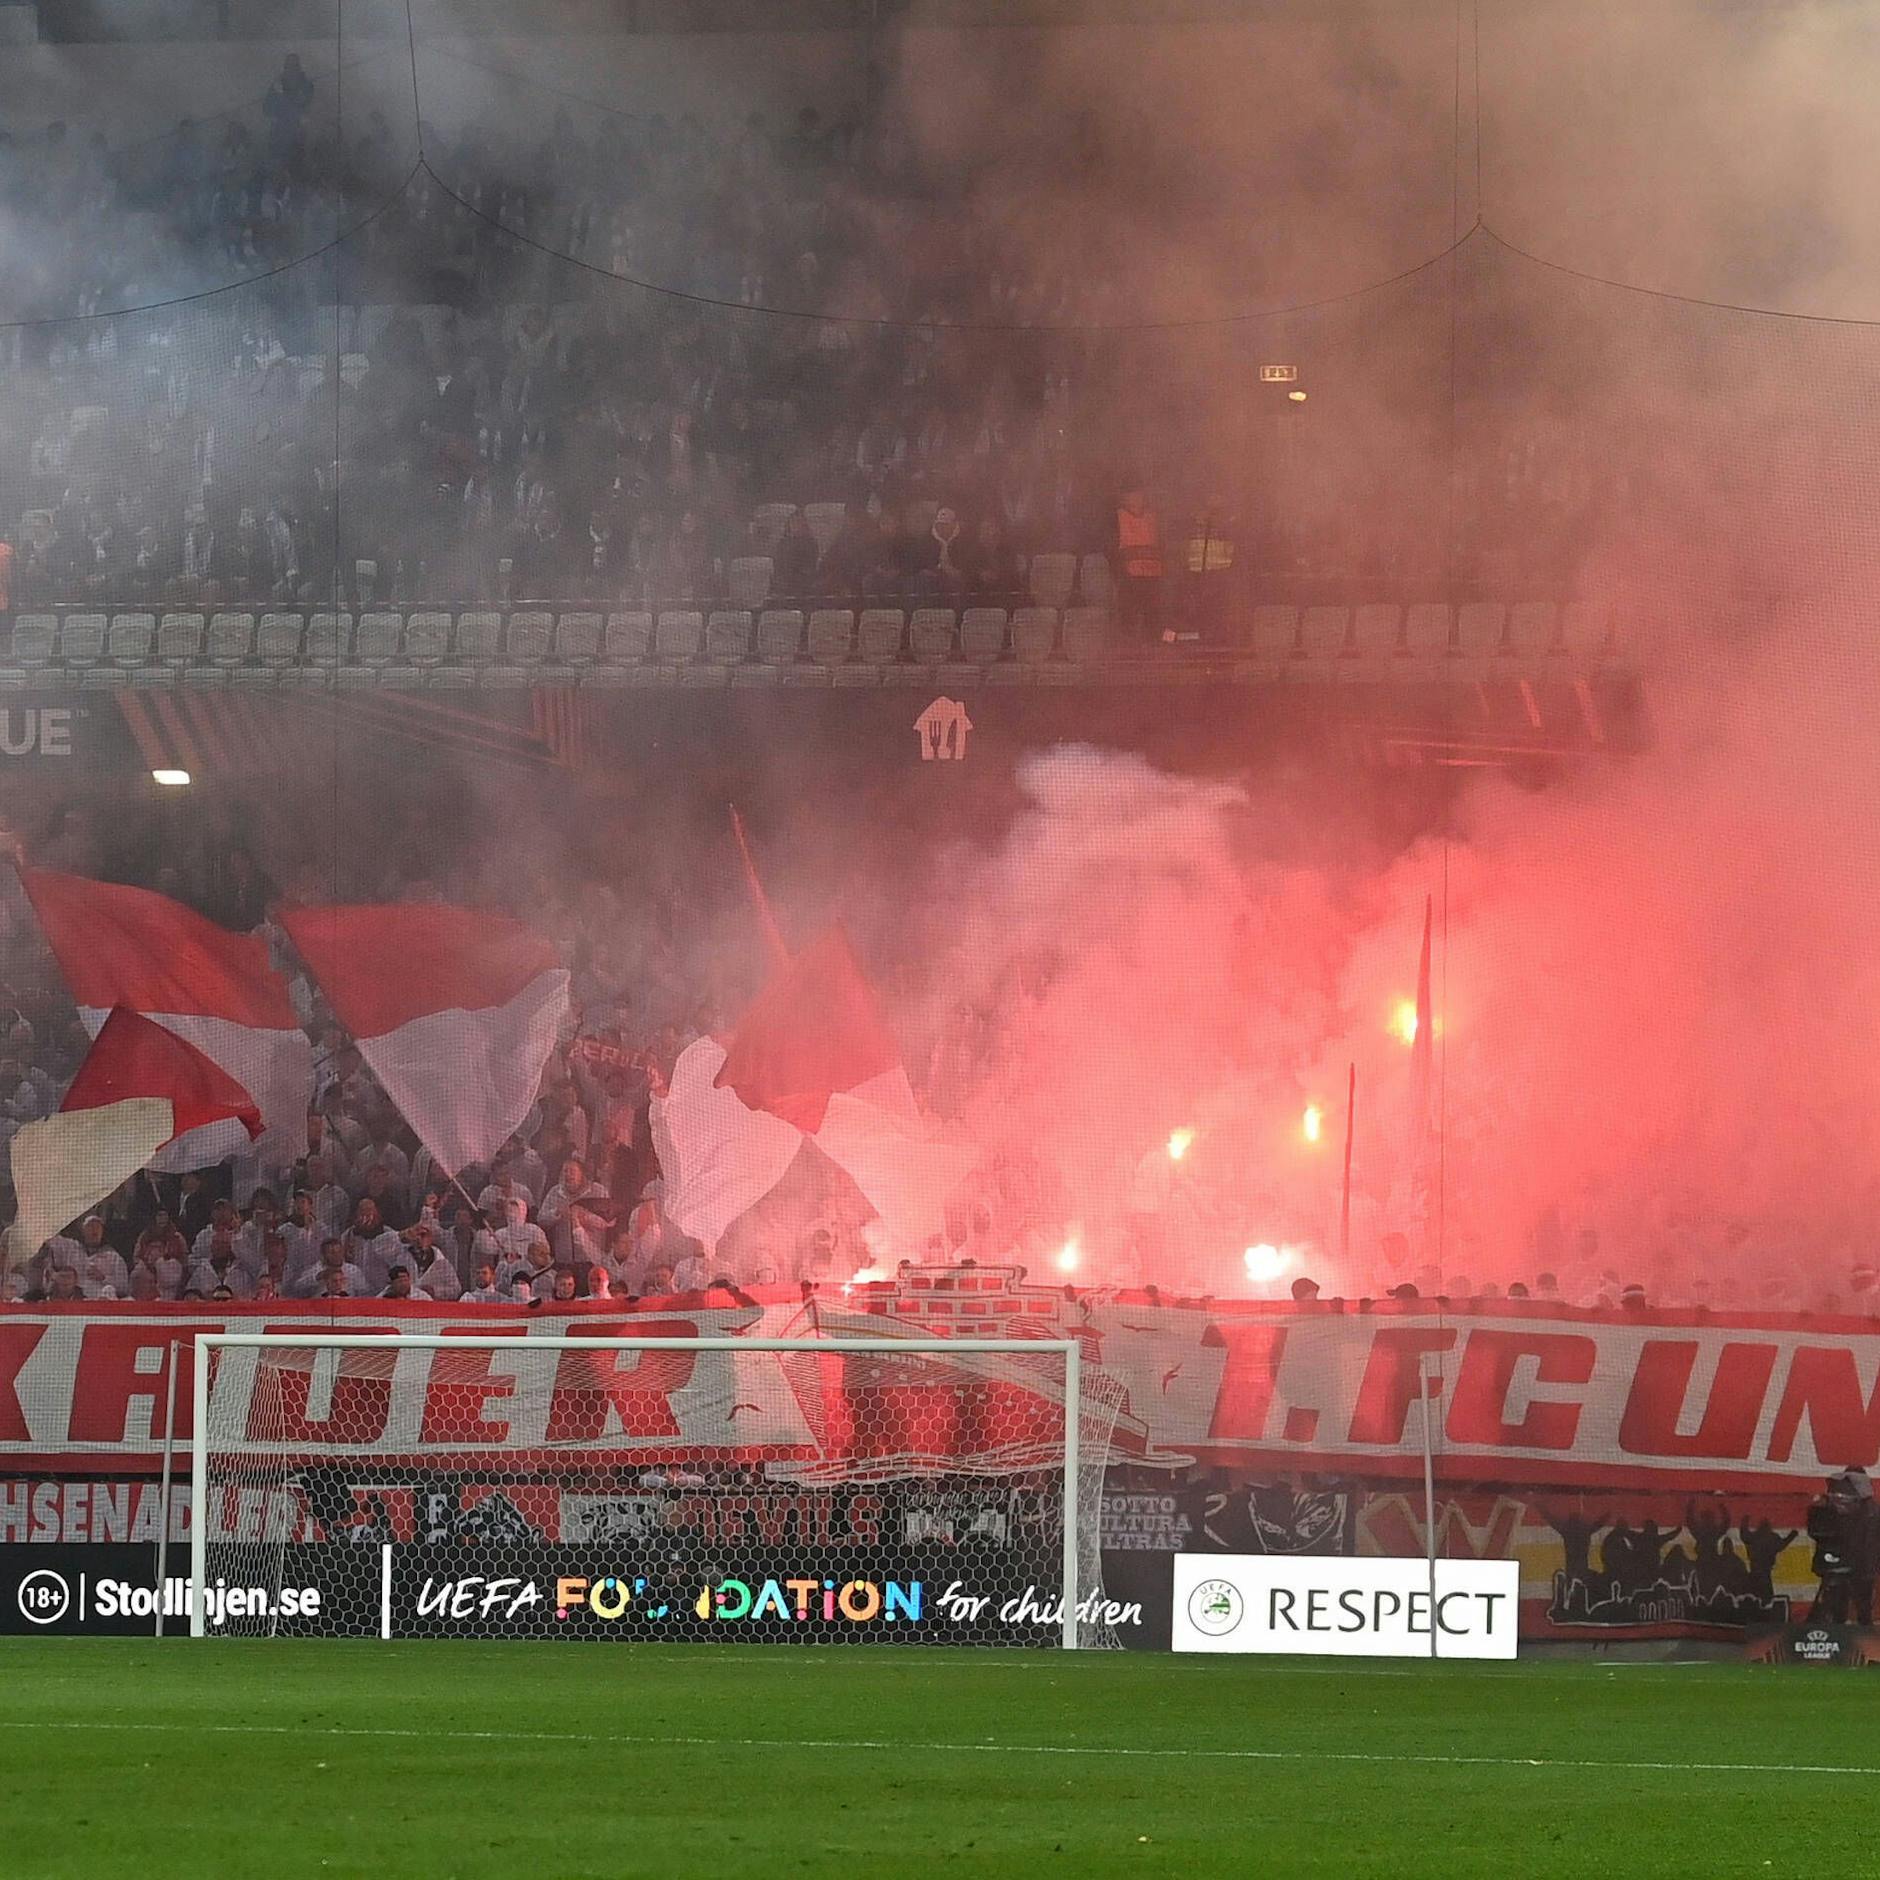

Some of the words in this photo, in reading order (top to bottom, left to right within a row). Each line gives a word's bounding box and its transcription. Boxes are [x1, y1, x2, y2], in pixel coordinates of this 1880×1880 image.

[1091, 1533, 1185, 1550] LTRAS
[27, 1587, 62, 1609] 18+
[416, 1576, 544, 1619] UEFA
[556, 1577, 923, 1622] FODATION
[936, 1580, 990, 1622] for
[1000, 1584, 1142, 1626] children
[1269, 1588, 1506, 1635] RESPECT
[1795, 1642, 1840, 1652] EUROPA
